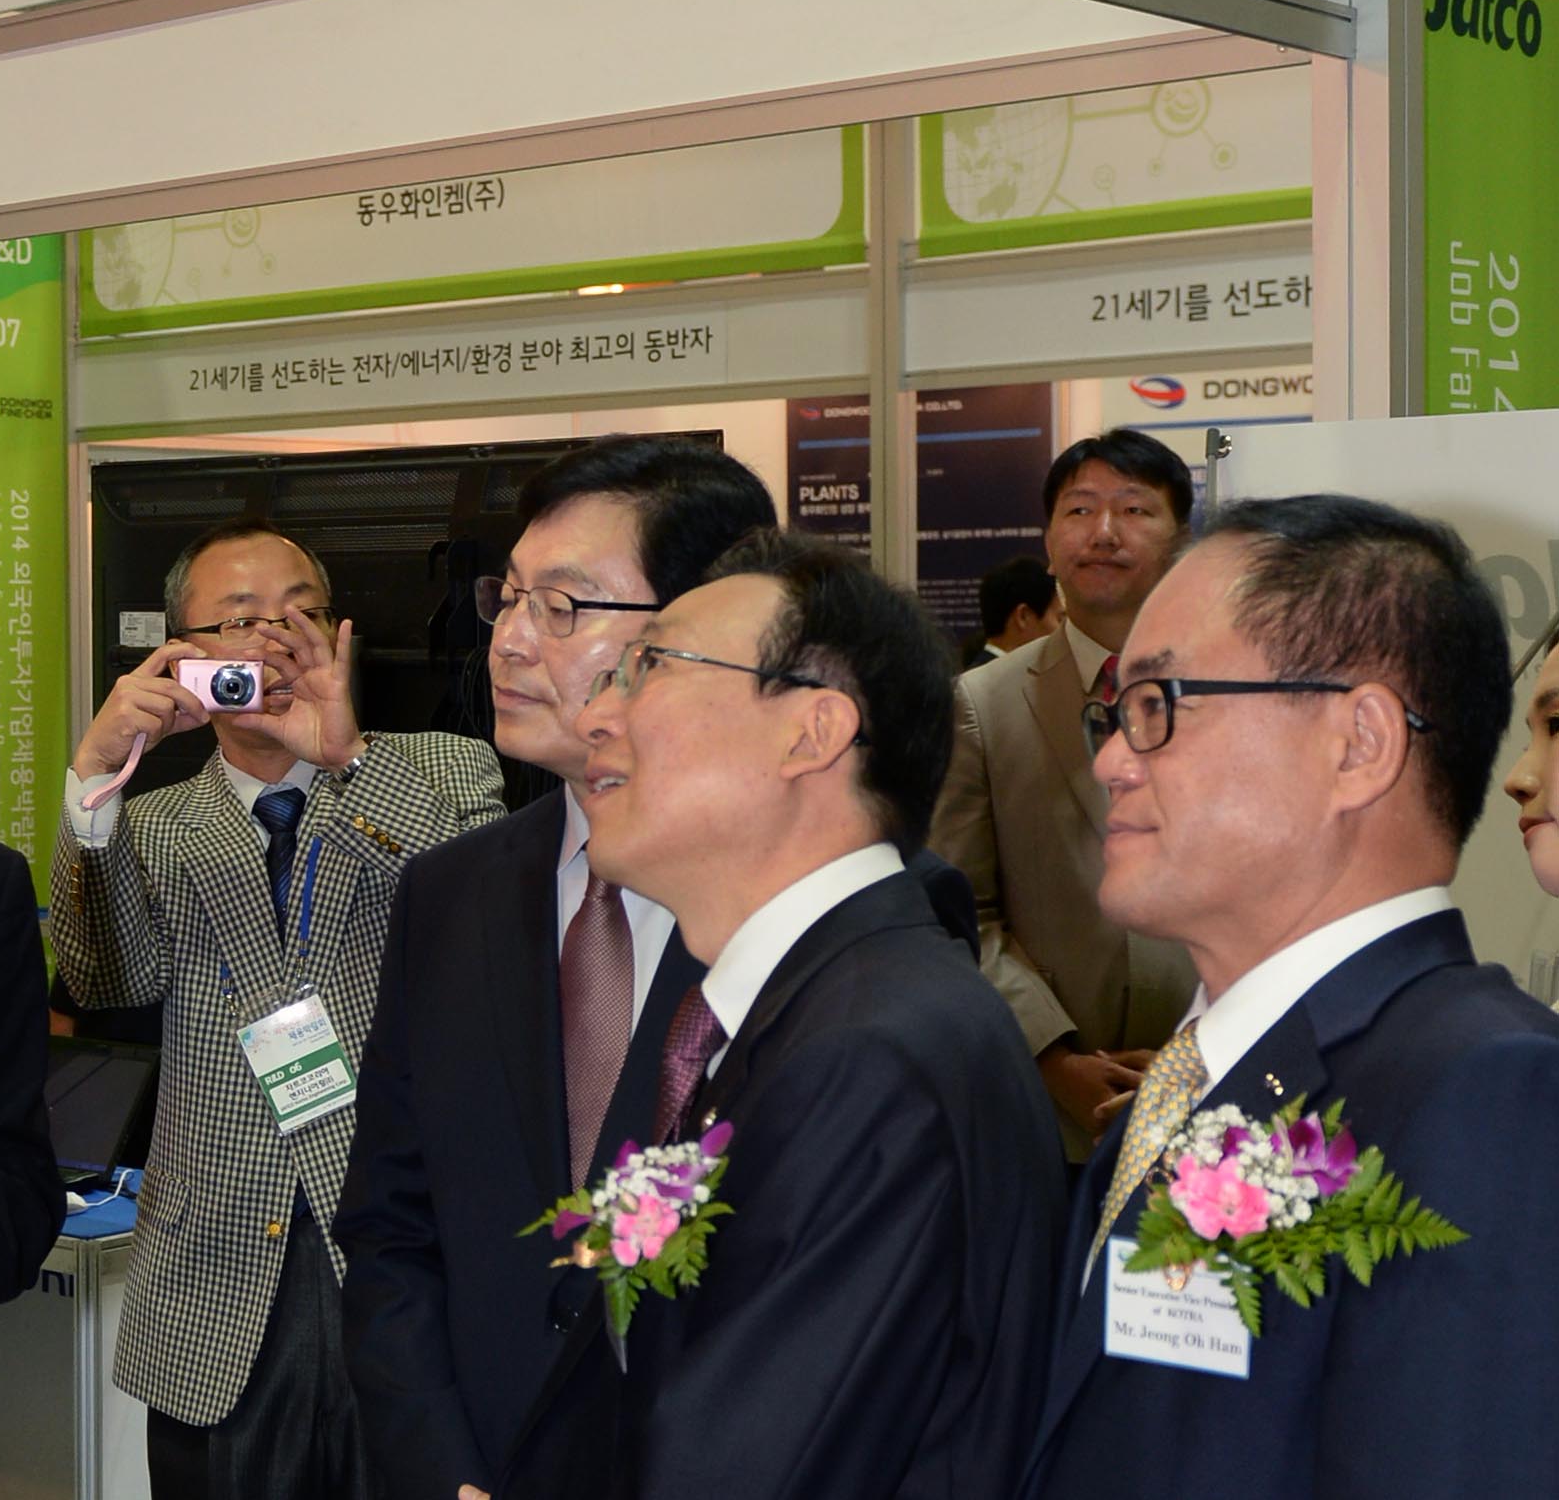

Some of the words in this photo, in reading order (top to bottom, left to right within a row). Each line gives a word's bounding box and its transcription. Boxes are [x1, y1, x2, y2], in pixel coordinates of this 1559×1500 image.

[356, 177, 506, 228] 동우화인켐(주)
[1091, 282, 1213, 324] 21세기를
[1223, 274, 1313, 317] 선도하
[1449, 240, 1481, 326] Job
[188, 363, 265, 393] 21세기를
[271, 357, 346, 390] 선도하는
[351, 341, 513, 379] 전자/에너지/환경
[518, 337, 564, 372] 분야
[568, 331, 636, 364] 최고의
[643, 325, 714, 363] 동반자
[1449, 346, 1481, 410] Fai
[9, 488, 32, 552] 2014
[799, 484, 860, 502] PLANTS
[1114, 1320, 1137, 1338] Mr.
[1140, 1324, 1181, 1349] Jeong
[1184, 1332, 1205, 1350] Oh
